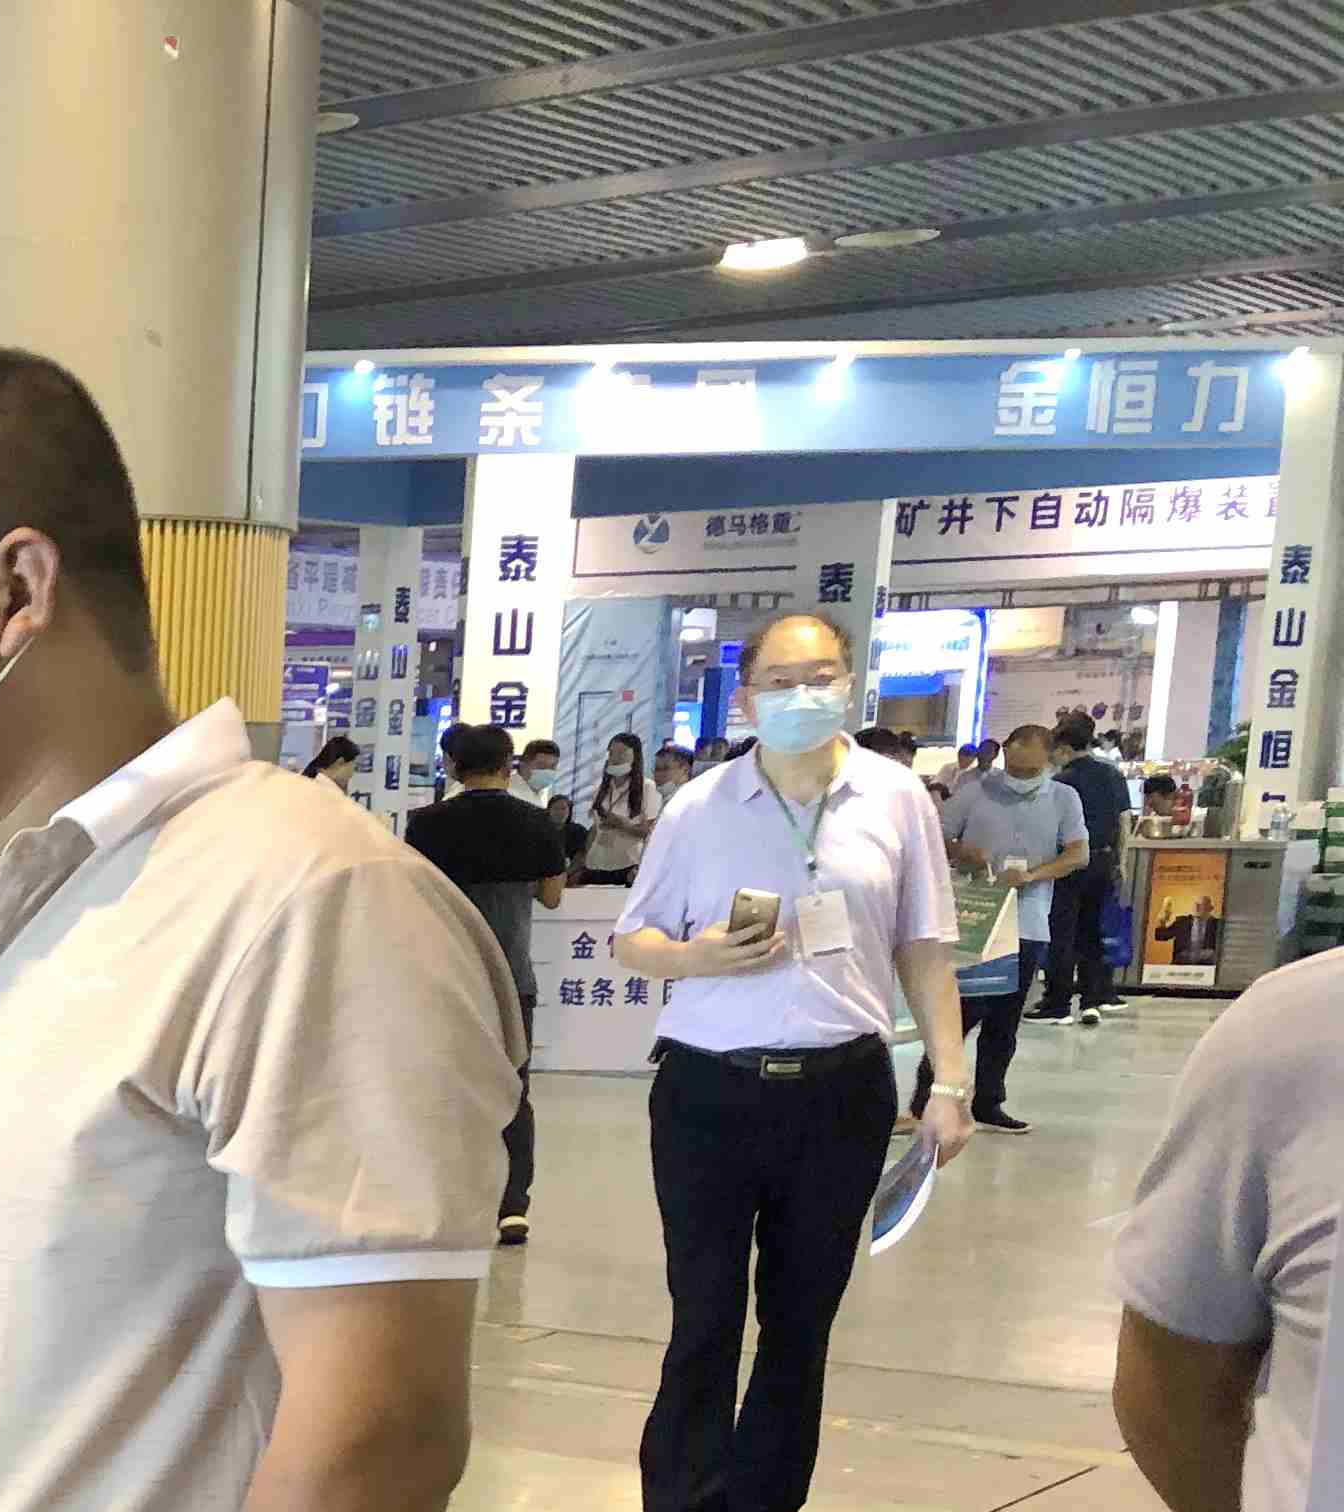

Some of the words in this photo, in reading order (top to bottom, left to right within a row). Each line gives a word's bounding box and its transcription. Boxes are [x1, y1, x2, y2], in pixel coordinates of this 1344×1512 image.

[994, 358, 1249, 437] 金恒力
[489, 534, 539, 765] 泰山金
[1259, 543, 1313, 802] 泰山金恒
